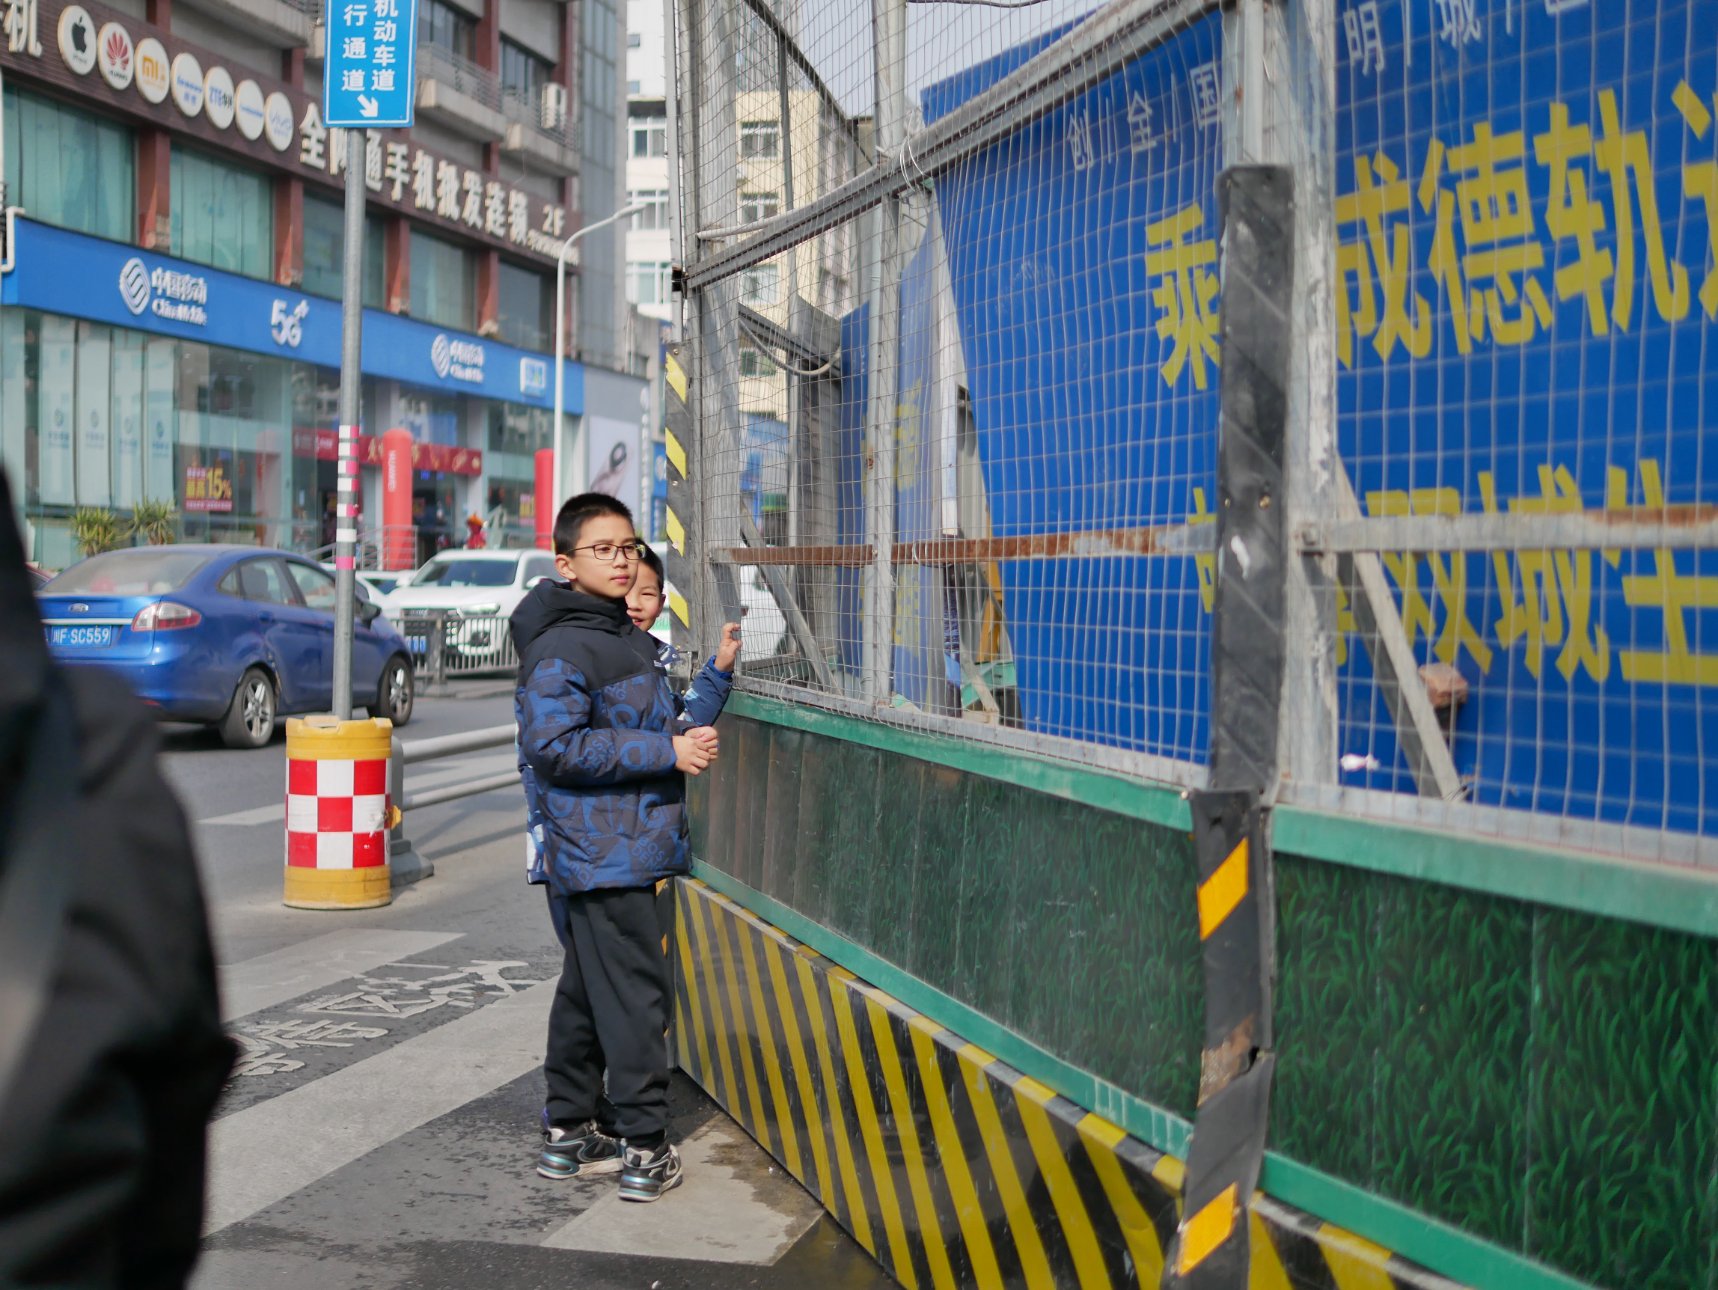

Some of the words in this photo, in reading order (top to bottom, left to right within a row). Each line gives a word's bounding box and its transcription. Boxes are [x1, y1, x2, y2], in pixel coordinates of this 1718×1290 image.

[341, 4, 367, 91] 行通道
[371, 0, 398, 91] 机动车道
